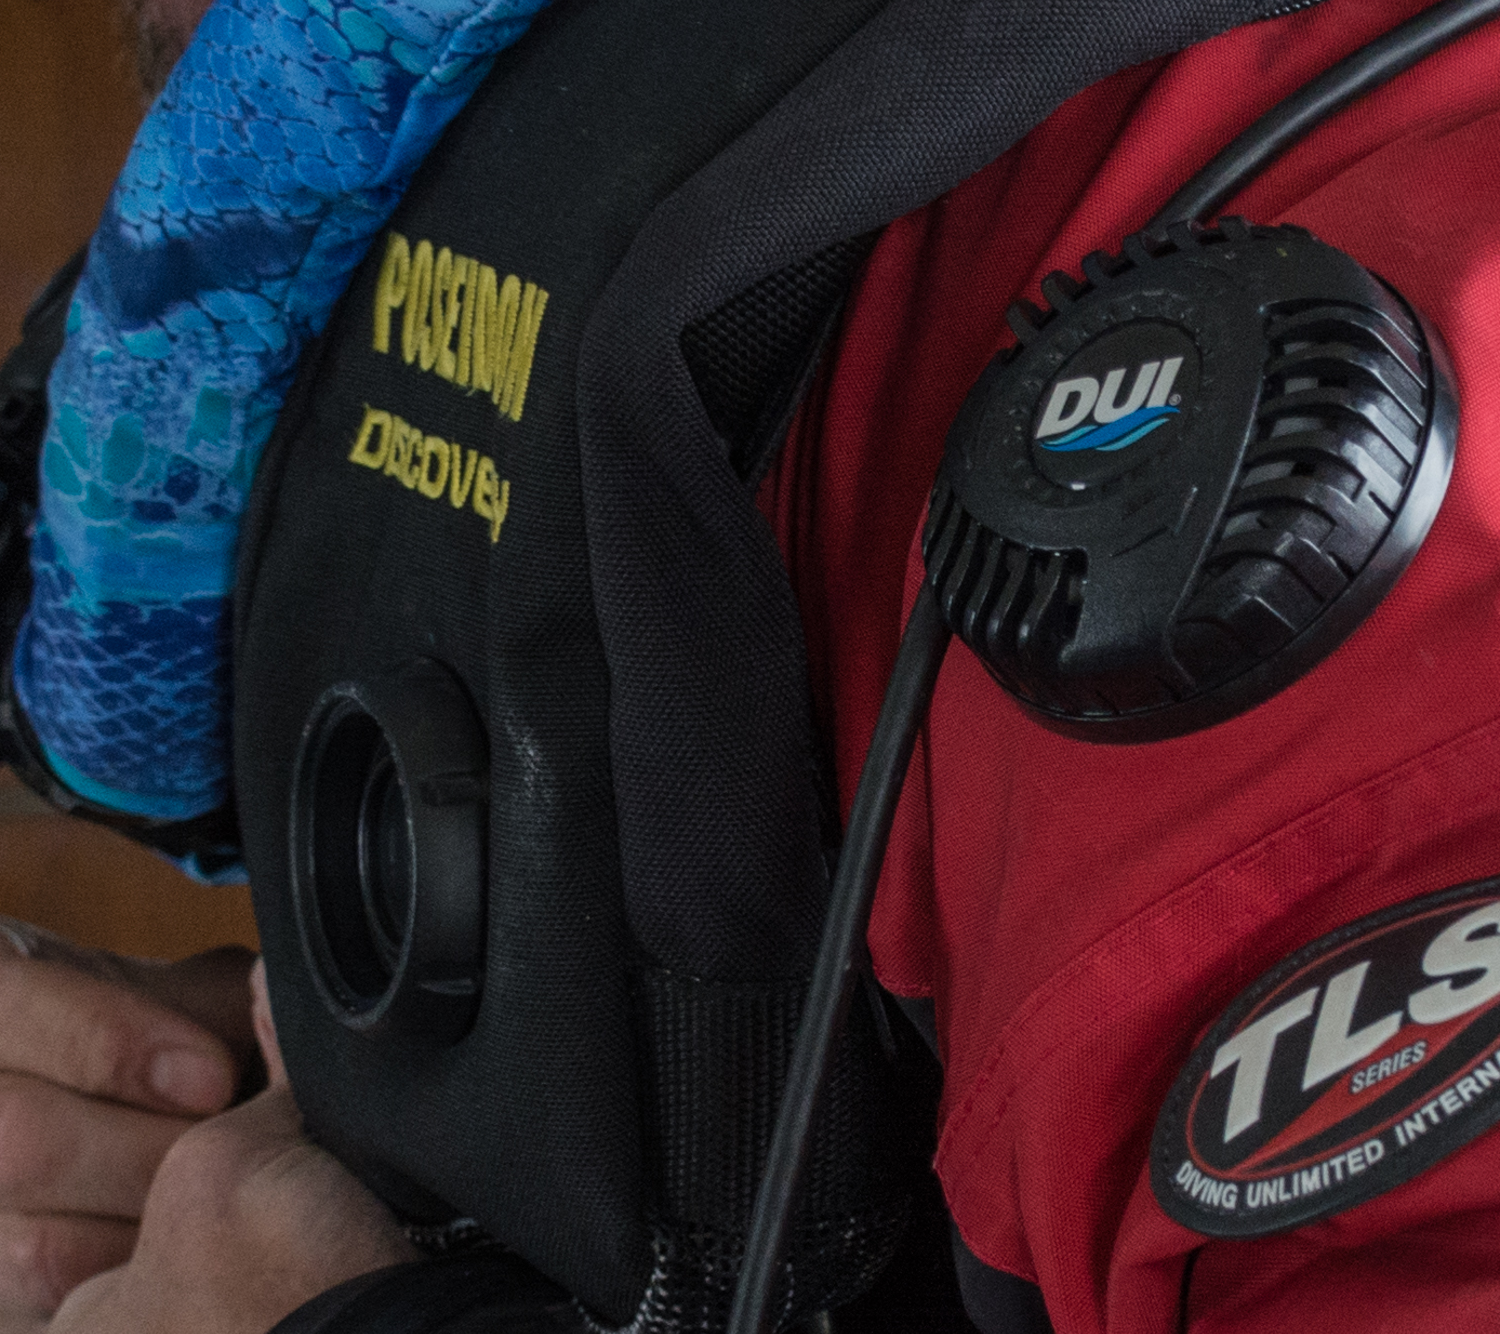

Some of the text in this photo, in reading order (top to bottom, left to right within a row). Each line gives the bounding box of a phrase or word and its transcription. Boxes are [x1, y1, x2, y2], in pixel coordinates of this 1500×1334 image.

[372, 231, 550, 423] POSEIDON
[1035, 356, 1184, 439] DUI
[1350, 1041, 1427, 1095] SERIES
[1175, 1160, 1239, 1210] DIVING
[1246, 1139, 1385, 1209] UNLIMITED
